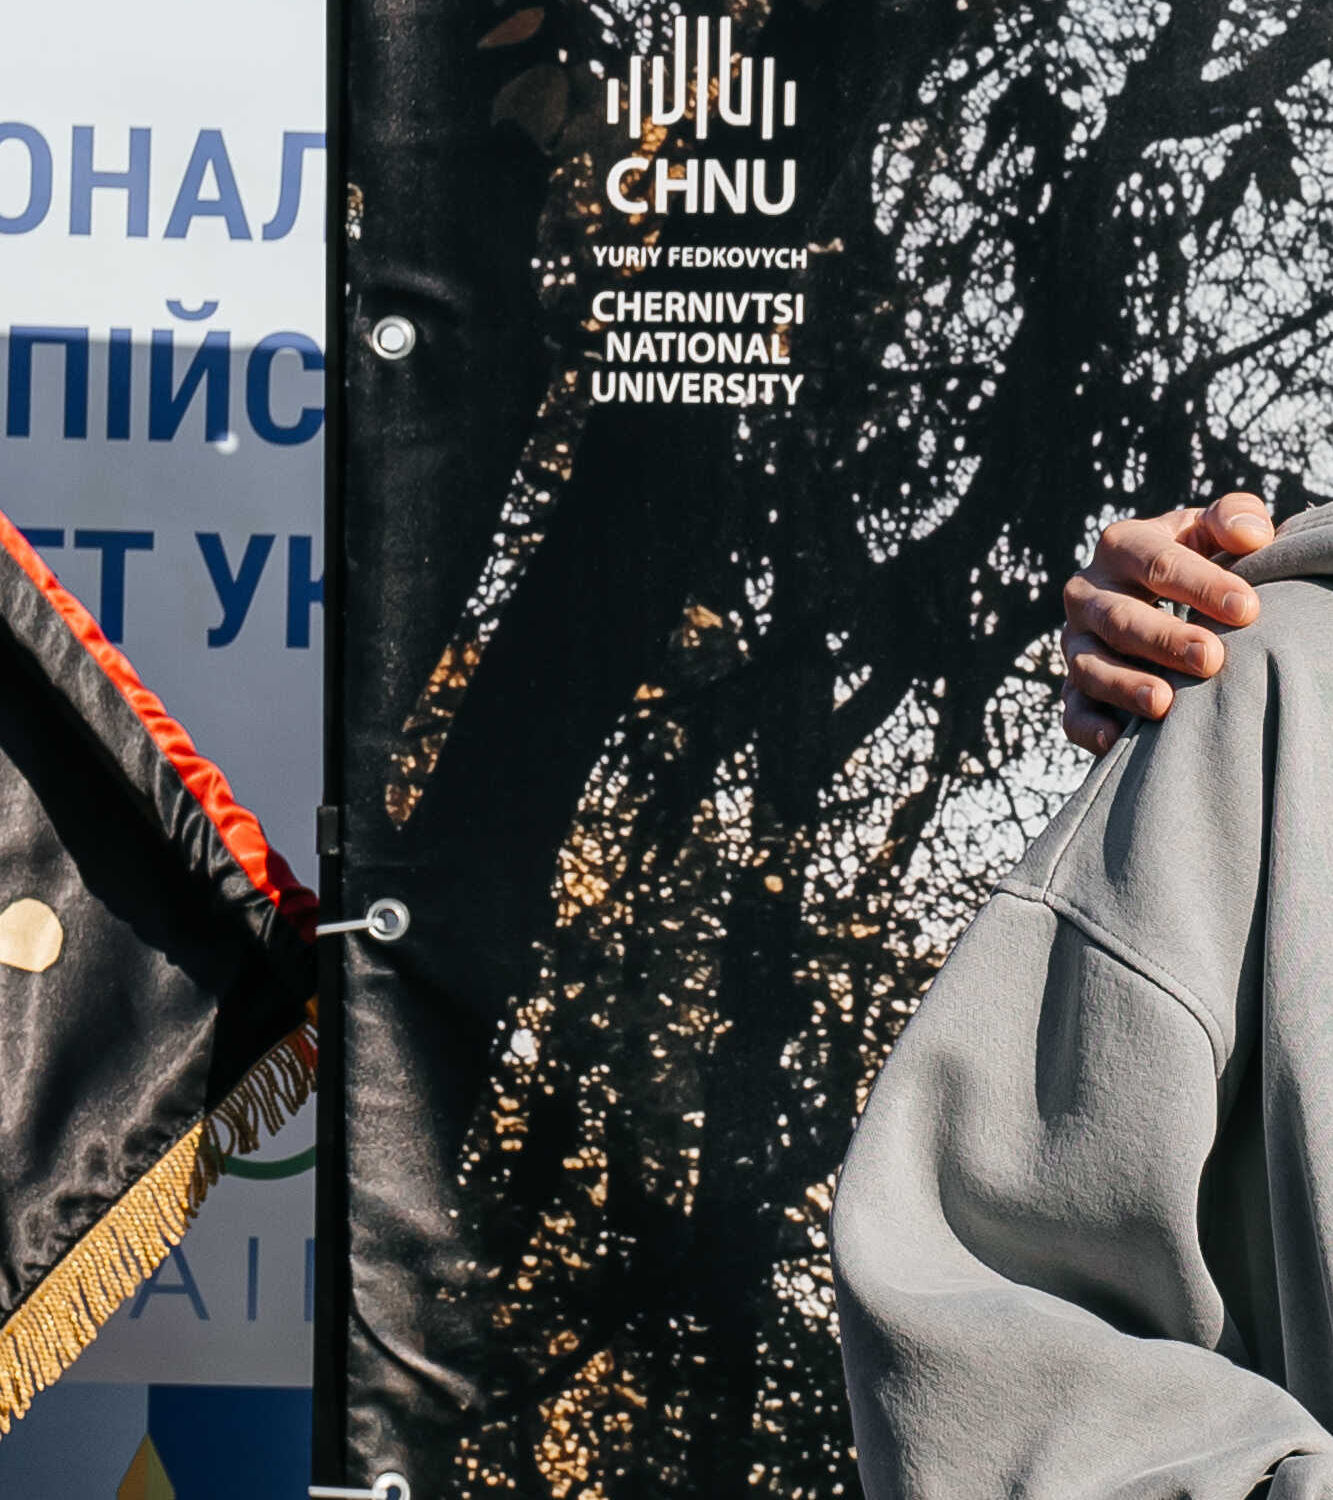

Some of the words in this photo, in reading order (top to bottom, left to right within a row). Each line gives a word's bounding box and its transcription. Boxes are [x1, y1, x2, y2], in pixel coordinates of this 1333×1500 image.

[606, 158, 797, 216] CHNU
[592, 245, 662, 269] YURIY
[667, 245, 808, 270] FEDKOVYCH
[591, 290, 805, 325] CHERNIVTSI
[605, 332, 790, 365] NATIONAL
[591, 372, 804, 406] UNIVERSITY
